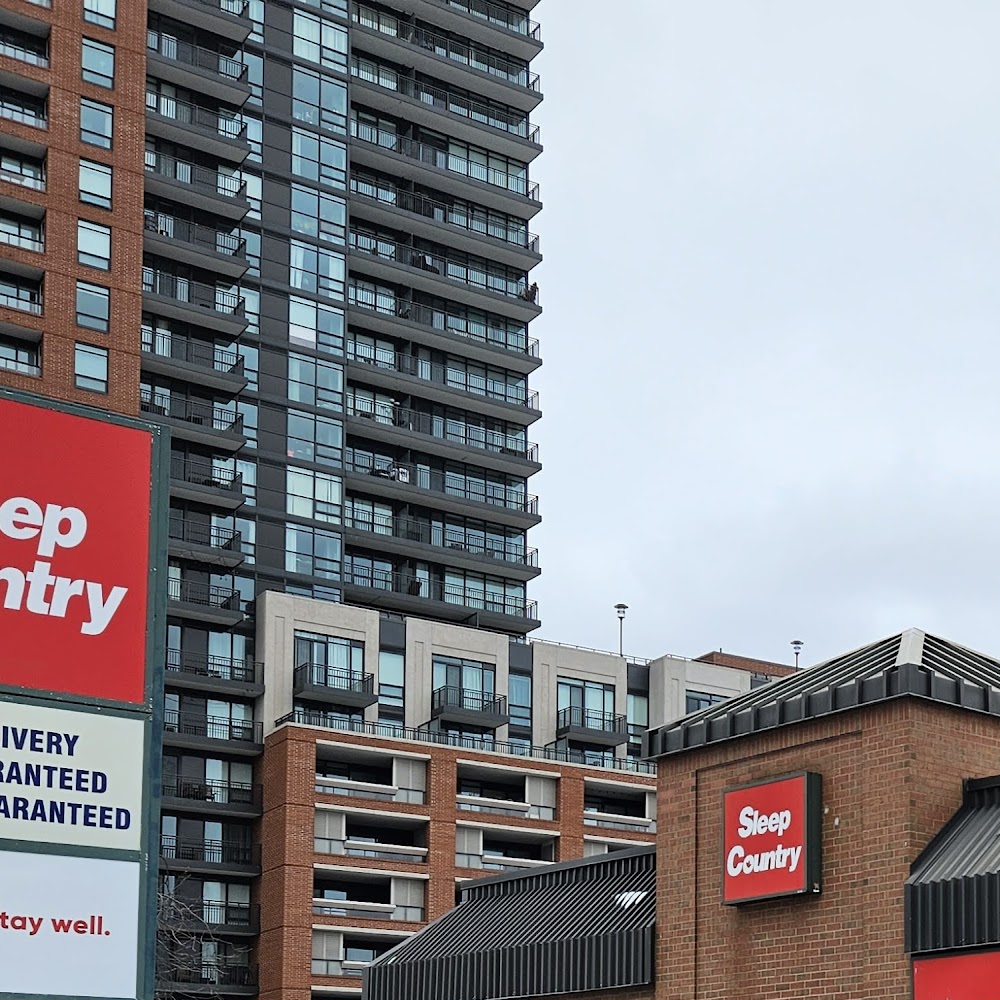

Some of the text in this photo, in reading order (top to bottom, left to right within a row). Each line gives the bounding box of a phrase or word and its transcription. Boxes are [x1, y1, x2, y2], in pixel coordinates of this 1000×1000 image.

[0, 496, 88, 558] ep
[2, 725, 80, 757] IVERY
[737, 805, 791, 838] Sleep
[726, 844, 802, 877] Country
[51, 915, 111, 936] well.
